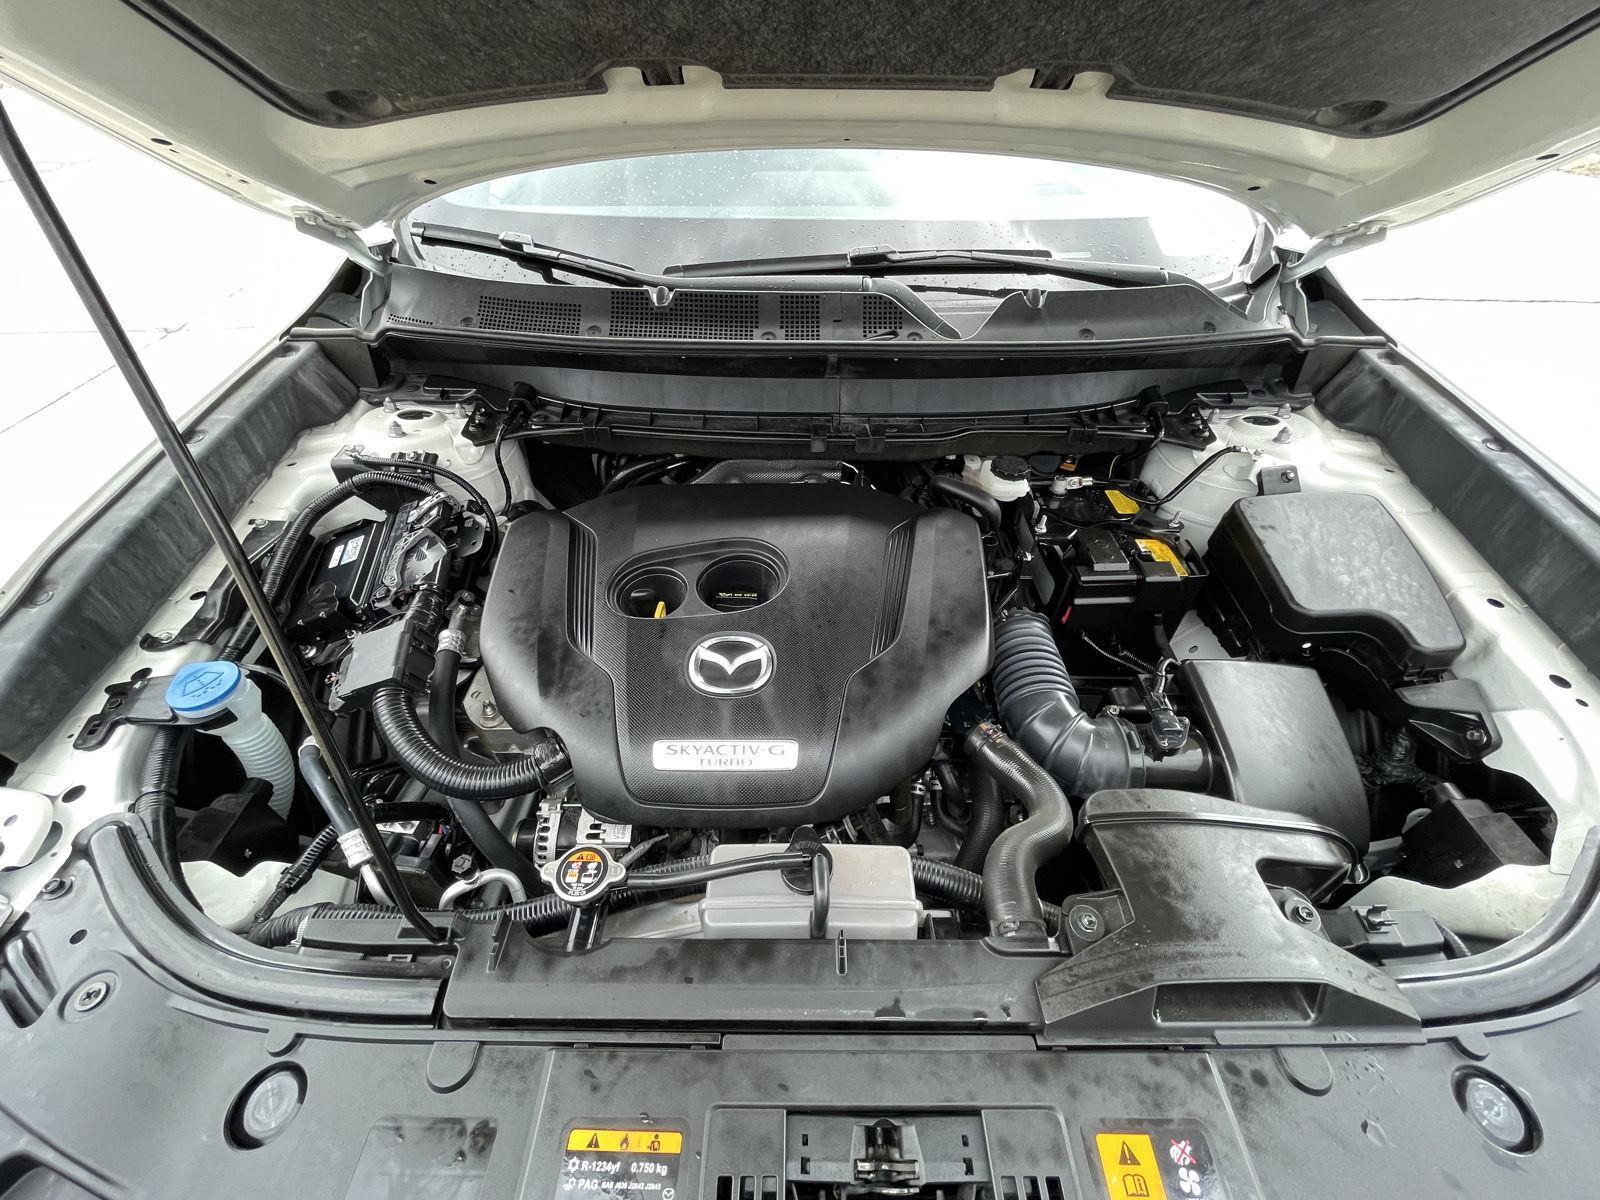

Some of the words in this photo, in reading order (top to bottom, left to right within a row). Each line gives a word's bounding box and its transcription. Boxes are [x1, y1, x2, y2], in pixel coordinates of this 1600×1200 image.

[665, 744, 785, 756] SKYACTIV-G
[699, 758, 753, 766] TURBO
[580, 1160, 622, 1174] R-1234yf
[630, 1162, 655, 1173] 0.750
[655, 1163, 668, 1176] kg
[577, 1179, 599, 1190] PAG
